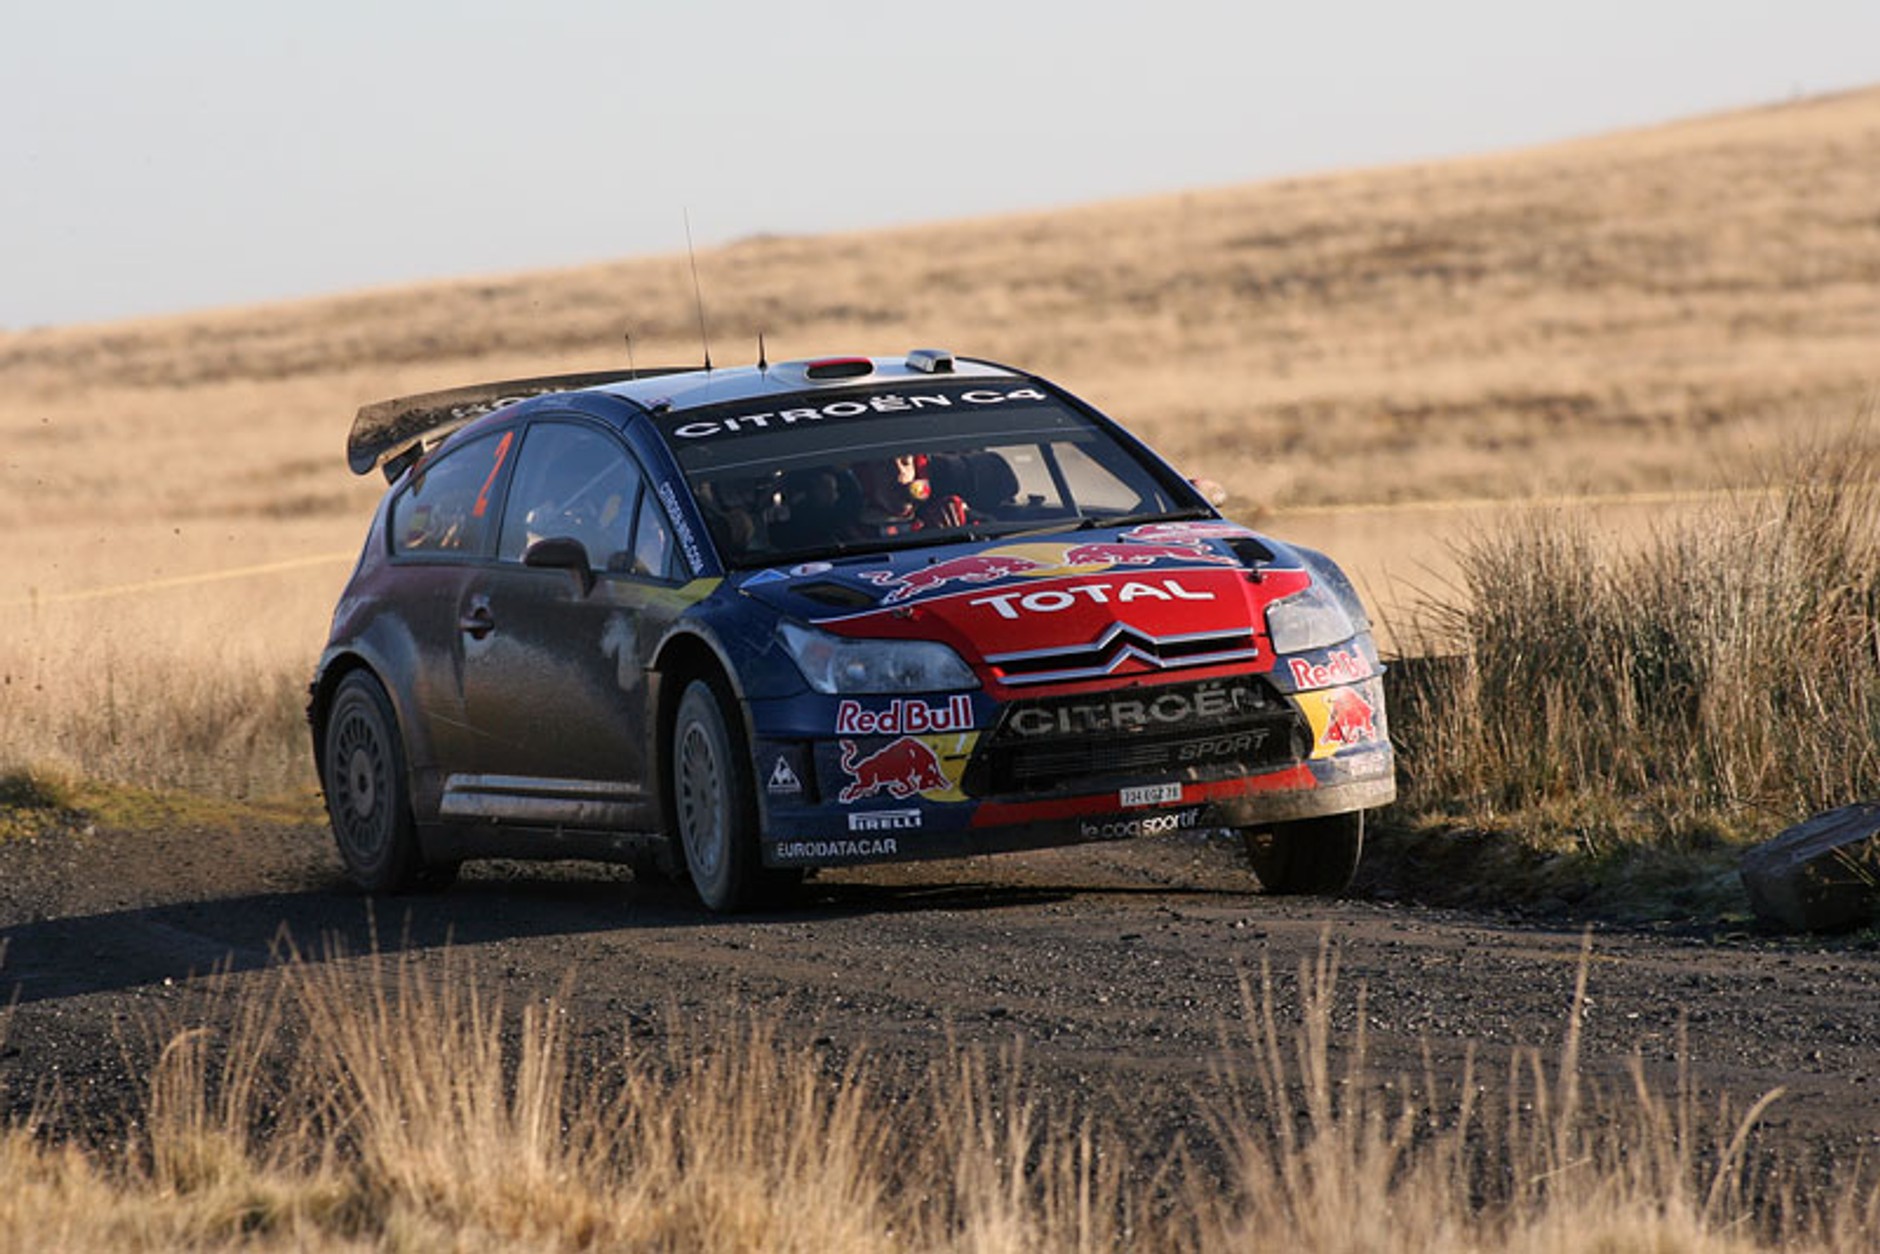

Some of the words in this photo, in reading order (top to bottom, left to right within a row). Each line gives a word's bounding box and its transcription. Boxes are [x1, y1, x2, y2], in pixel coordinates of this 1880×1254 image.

[674, 394, 951, 438] CITROËN
[961, 387, 1047, 403] C4
[970, 580, 1216, 619] TOTAL
[835, 699, 901, 734] Red
[903, 694, 974, 733] Bull
[1010, 681, 1264, 735] CITROËN
[1178, 732, 1269, 761] SPORT
[849, 809, 922, 831] PIRELLI
[776, 838, 898, 858] EURODATACAR
